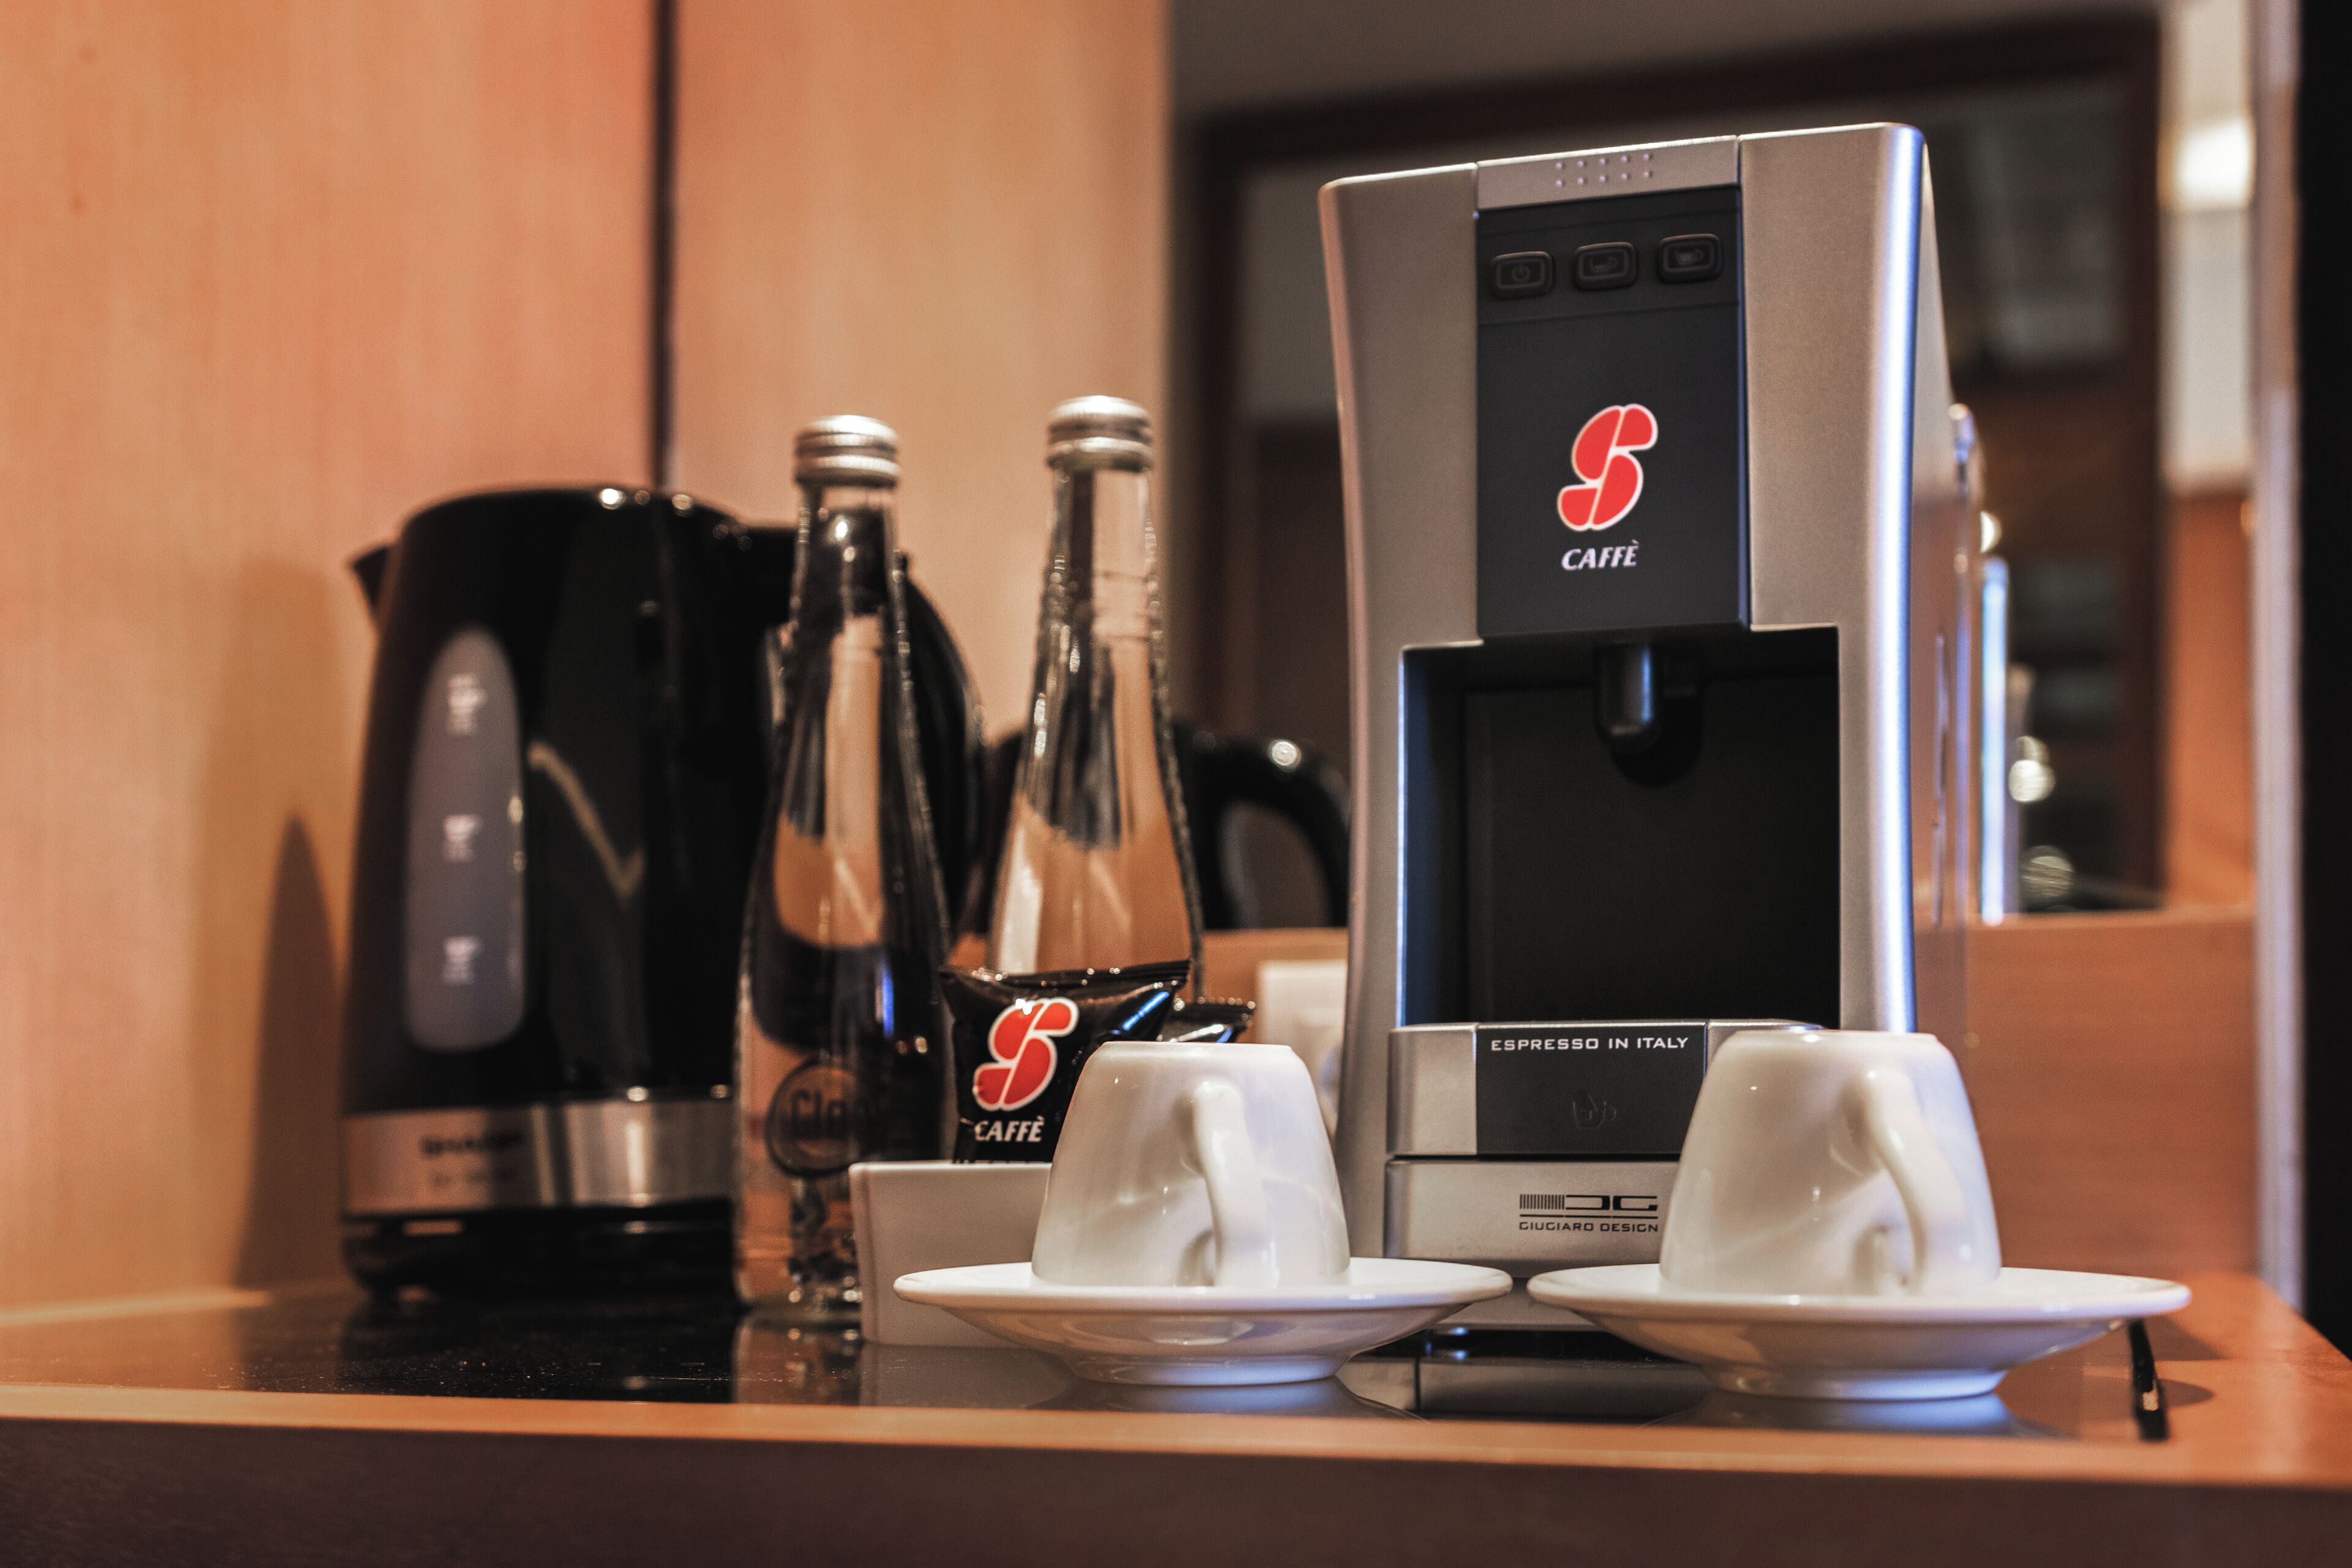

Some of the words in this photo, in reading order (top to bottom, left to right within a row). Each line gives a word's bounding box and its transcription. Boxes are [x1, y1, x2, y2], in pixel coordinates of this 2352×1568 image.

[1562, 539, 1639, 571] CAFFÈ
[1491, 1038, 1599, 1051] ESPRESSO
[1608, 1038, 1629, 1049] IN
[1637, 1037, 1689, 1049] ITALY
[974, 1115, 1045, 1142] CAFFÈ
[1519, 1221, 1594, 1232] GIUGIARO
[1600, 1223, 1659, 1233] DESIGN
